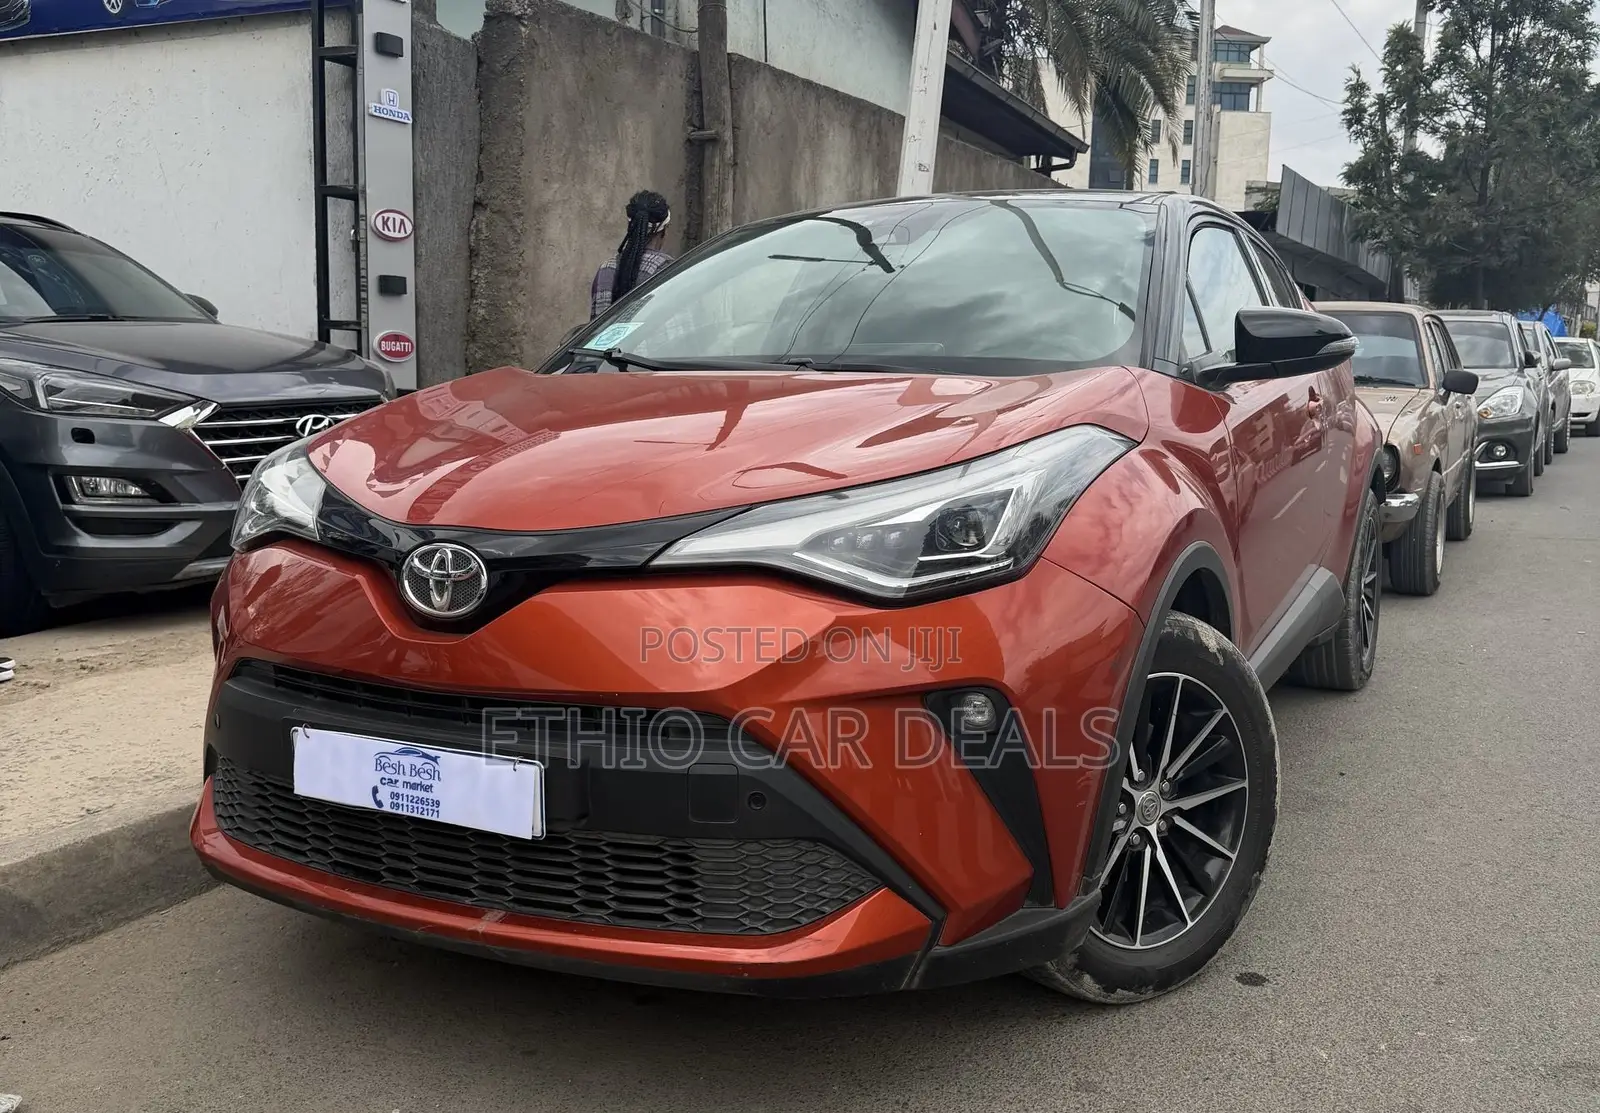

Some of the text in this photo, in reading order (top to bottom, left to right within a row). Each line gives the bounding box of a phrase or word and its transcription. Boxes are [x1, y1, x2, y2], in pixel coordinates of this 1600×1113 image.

[373, 105, 411, 121] HONDA
[381, 215, 408, 235] KIA
[380, 340, 412, 352] BUGATTI
[374, 756, 442, 782] Besh Besh
[379, 776, 434, 793] car market
[390, 791, 441, 808] 0911226539
[390, 801, 440, 818] 0911312171
